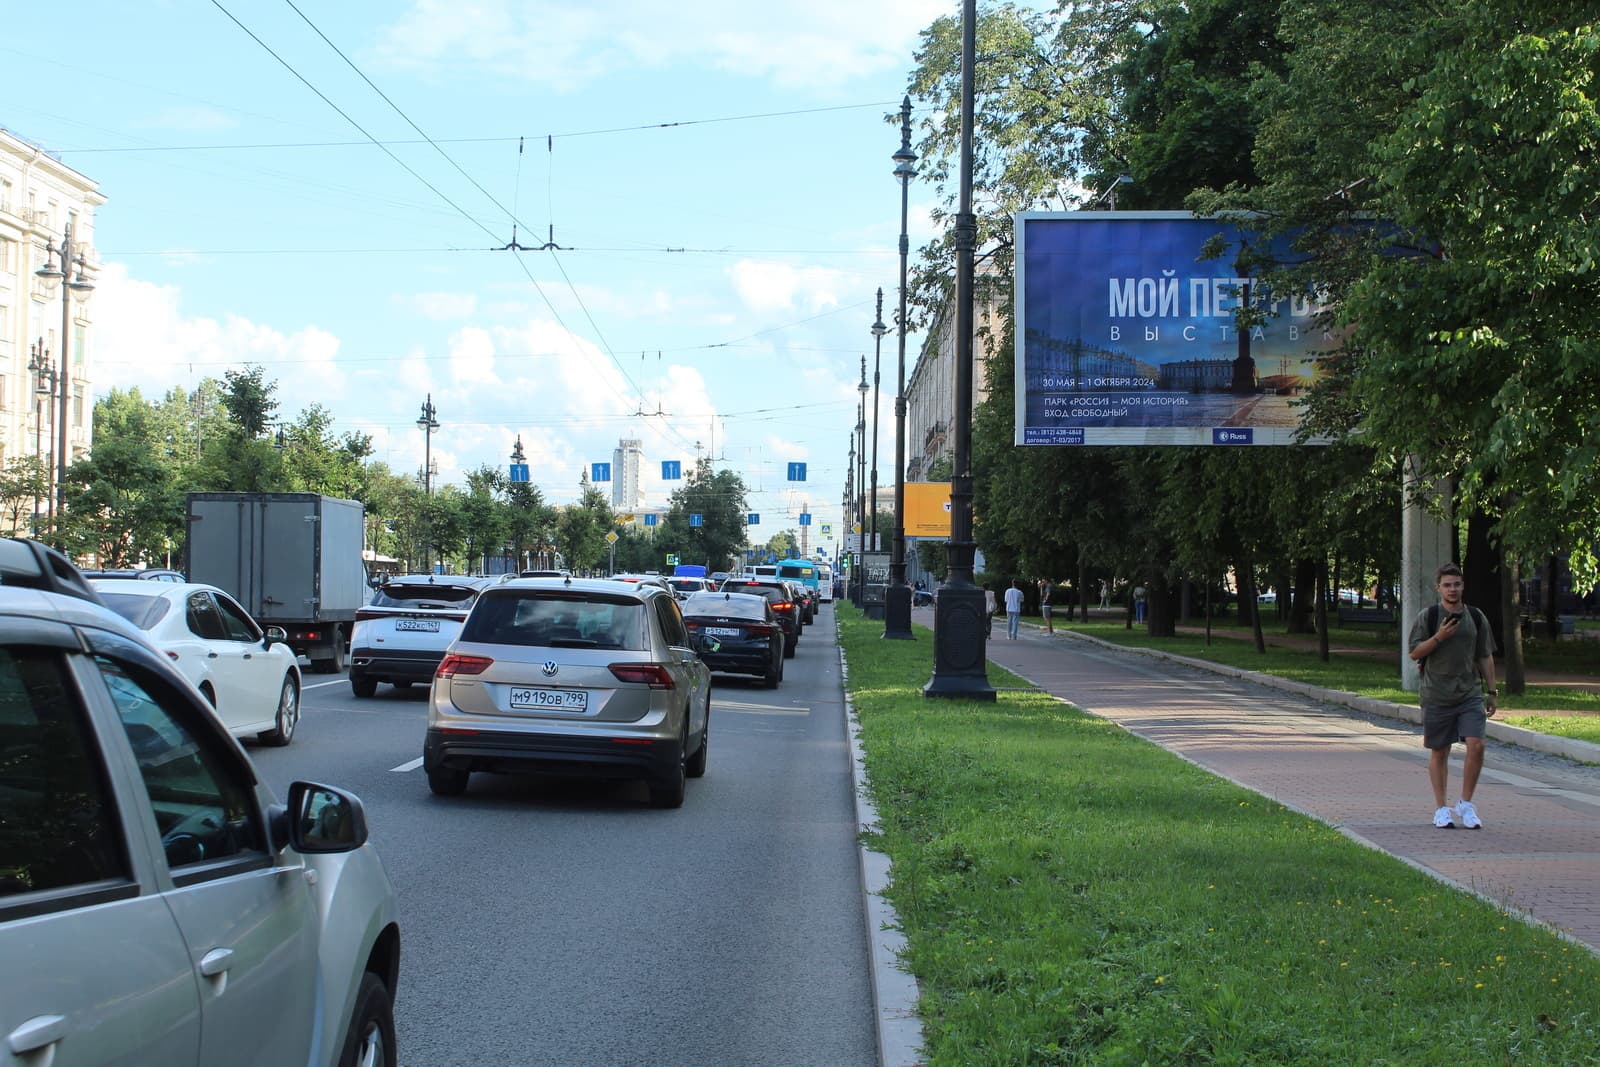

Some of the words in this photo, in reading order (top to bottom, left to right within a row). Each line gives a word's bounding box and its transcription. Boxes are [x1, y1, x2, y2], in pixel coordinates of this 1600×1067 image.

[1109, 269, 1179, 317] МОЙ
[1110, 325, 1337, 341] ВЫСТАВК
[1042, 378, 1054, 387] 30
[1056, 378, 1075, 387] МАЯ
[1087, 378, 1092, 386] 1
[1094, 377, 1131, 387] ОКТЯБРЯ
[1133, 377, 1155, 386] 2024
[1044, 397, 1068, 406] ПАРК
[1120, 397, 1141, 406] МОЯ
[1143, 397, 1189, 406] ИСТОРИЯ»
[1044, 409, 1069, 418] ВХОД
[1071, 406, 1128, 418] СВОБОДНЫЙ
[514, 690, 562, 704] М919ОВ
[563, 692, 583, 703] 799
